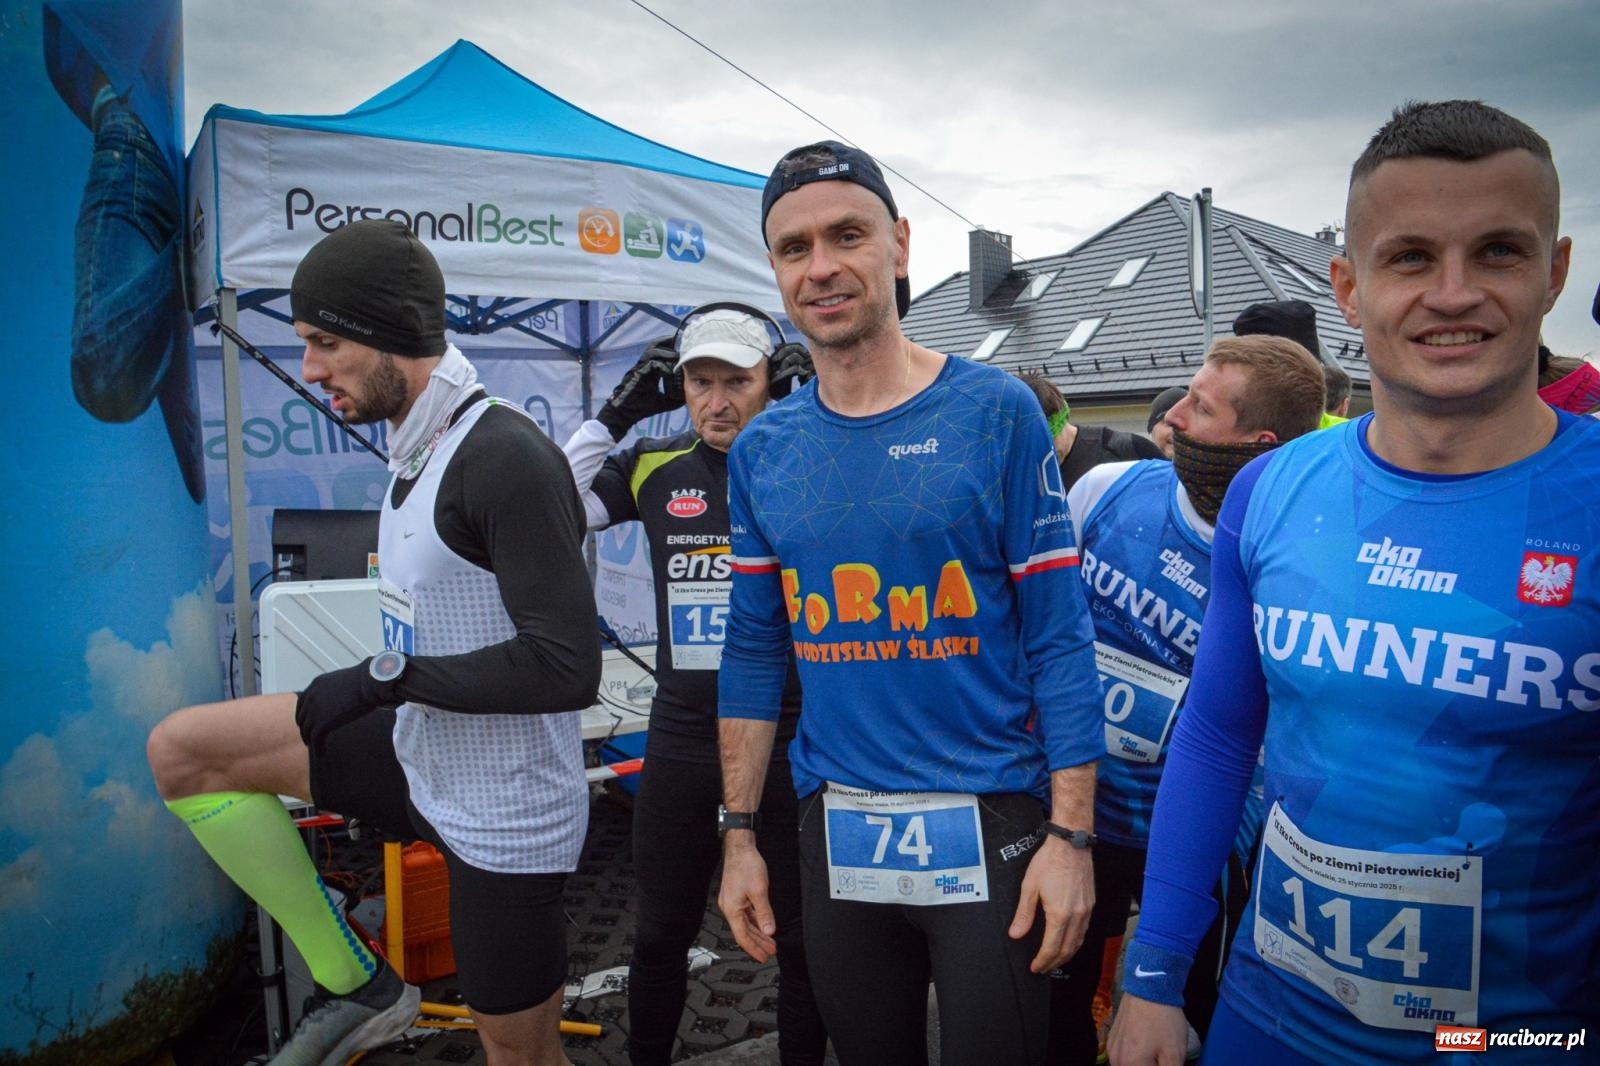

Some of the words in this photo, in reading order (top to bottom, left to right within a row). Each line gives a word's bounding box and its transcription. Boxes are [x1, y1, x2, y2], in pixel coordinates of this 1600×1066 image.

[818, 164, 839, 176] GAME
[839, 163, 850, 172] ON
[888, 438, 939, 460] quest
[671, 488, 707, 499] EASY
[673, 502, 700, 511] RUN
[666, 534, 730, 545] ENERGETYK
[1526, 538, 1581, 552] POLAND
[667, 552, 732, 579] ens
[686, 606, 731, 642] 15
[906, 634, 980, 662] ŚLĄSKI
[1252, 603, 1600, 712] RUNNERS
[1099, 674, 1136, 723] 0
[864, 814, 933, 867] 74
[1288, 835, 1309, 857] Cross
[1310, 852, 1324, 863] po
[1325, 856, 1362, 873] Ziemi
[1364, 862, 1460, 883] Pietrowickiej
[1282, 876, 1428, 978] 114
